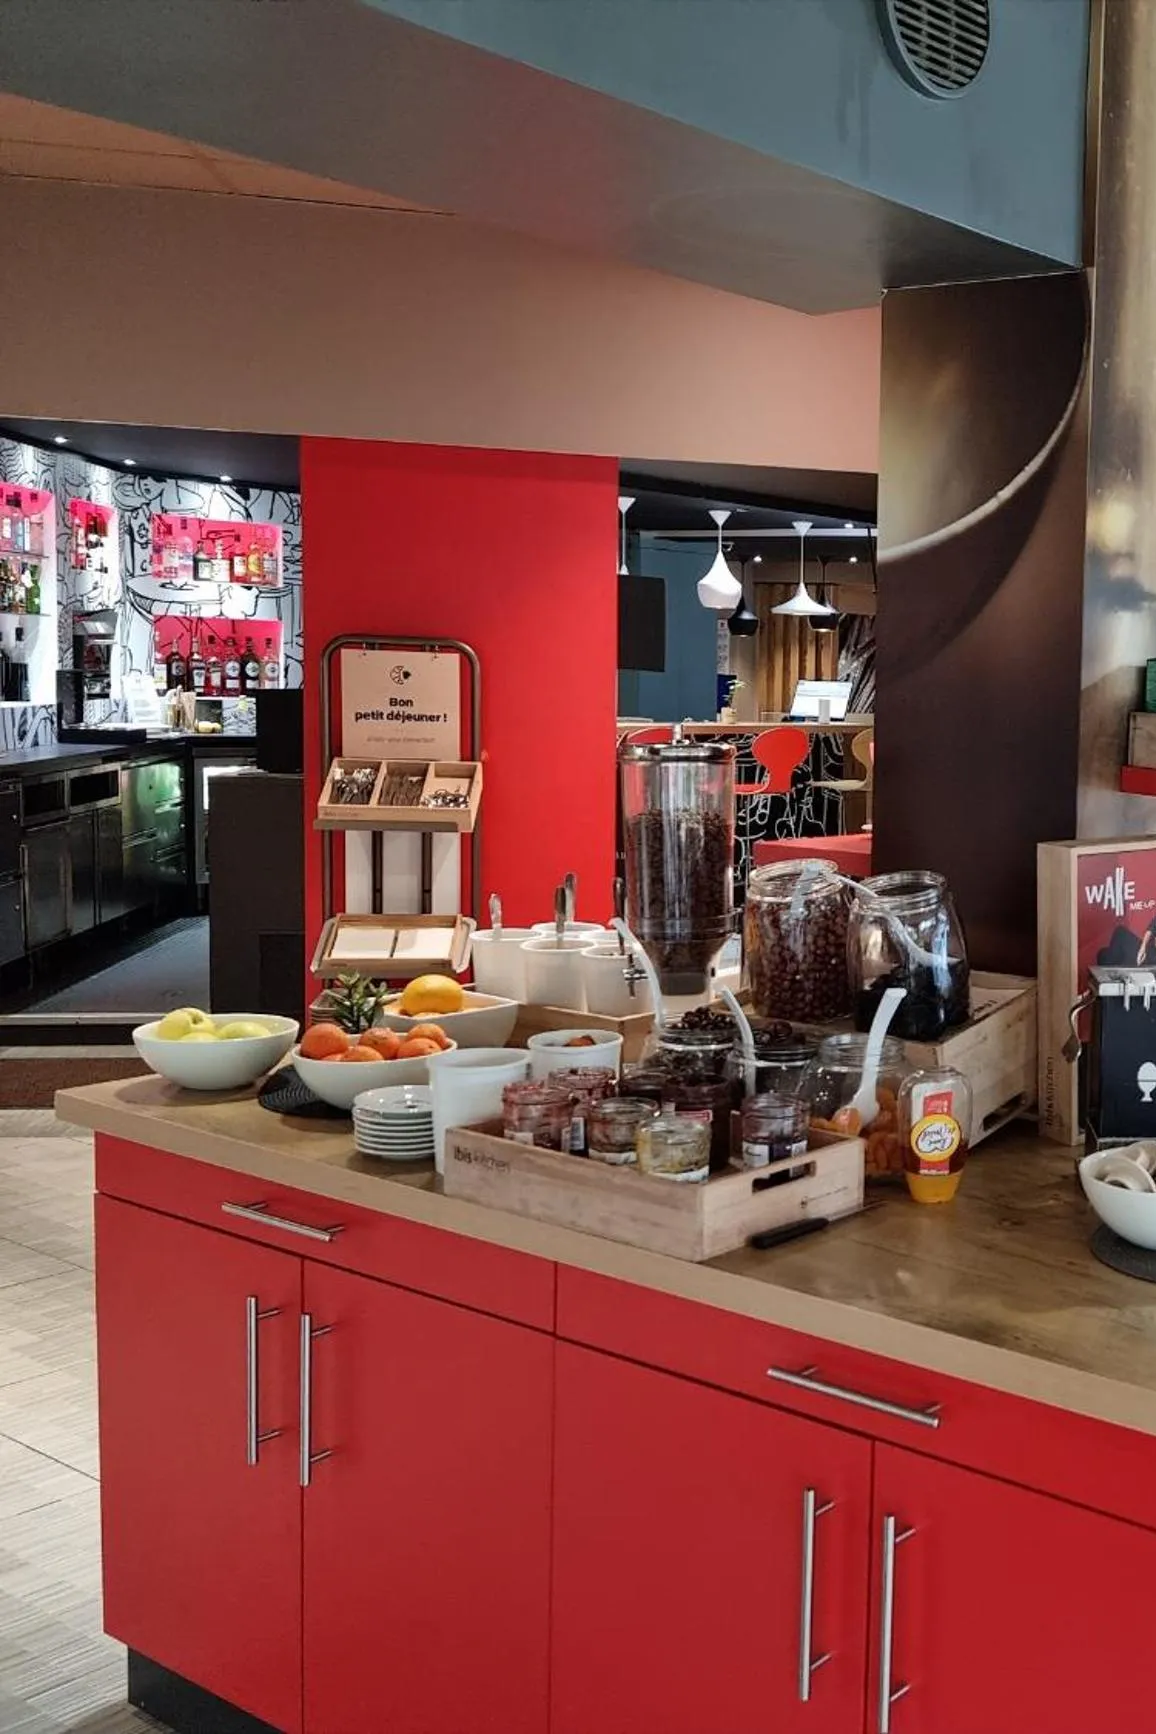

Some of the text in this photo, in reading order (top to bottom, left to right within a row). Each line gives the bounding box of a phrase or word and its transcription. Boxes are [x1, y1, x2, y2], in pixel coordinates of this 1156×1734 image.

[389, 698, 414, 707] Bon
[355, 710, 384, 722] petit
[386, 710, 441, 723] déjeuner
[1085, 866, 1135, 917] WAKE
